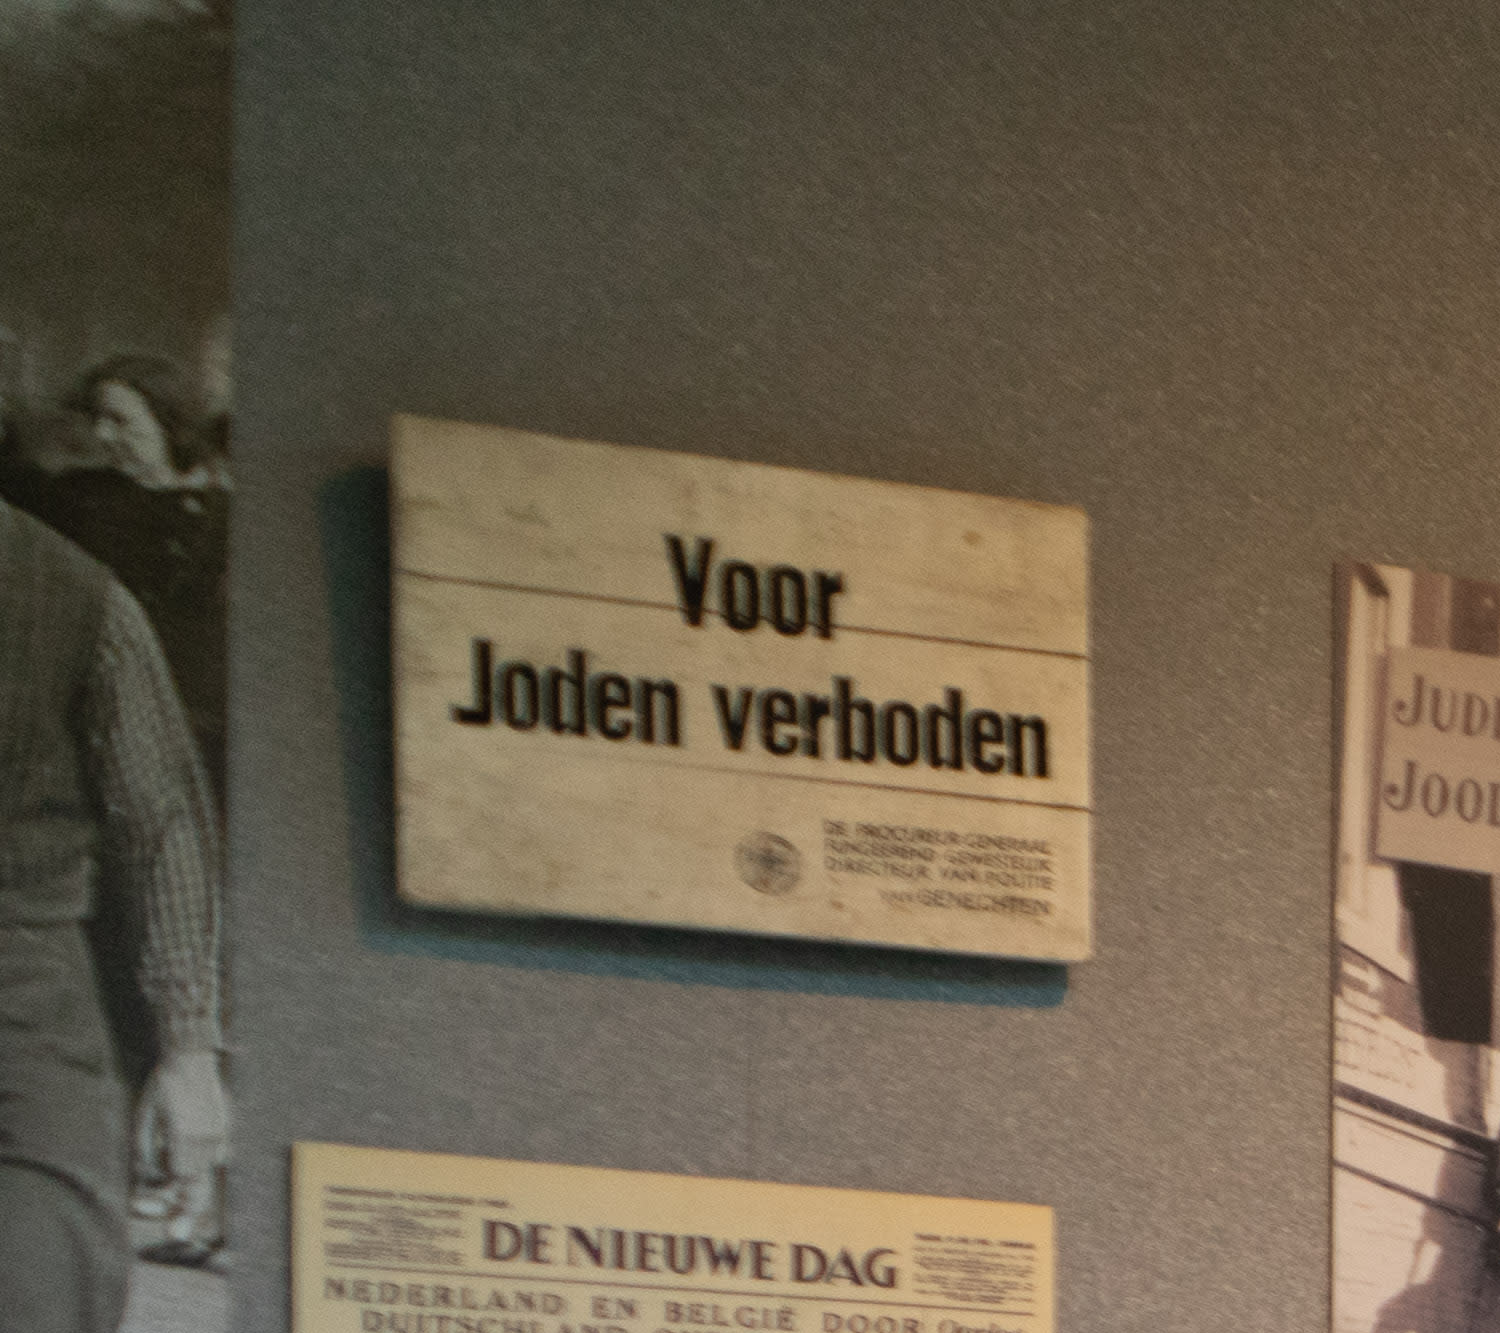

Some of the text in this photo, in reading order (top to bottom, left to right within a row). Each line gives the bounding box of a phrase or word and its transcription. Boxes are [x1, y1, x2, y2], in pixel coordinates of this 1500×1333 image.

[664, 532, 845, 640] Voor
[450, 635, 1053, 780] Joden verboden
[483, 1218, 552, 1265] DE
[567, 1224, 776, 1282] NIEUWE
[791, 1242, 898, 1289] DAG
[323, 1277, 567, 1316] NEDERLAND
[591, 1295, 639, 1321] EN
[663, 1299, 797, 1332] BELGIË
